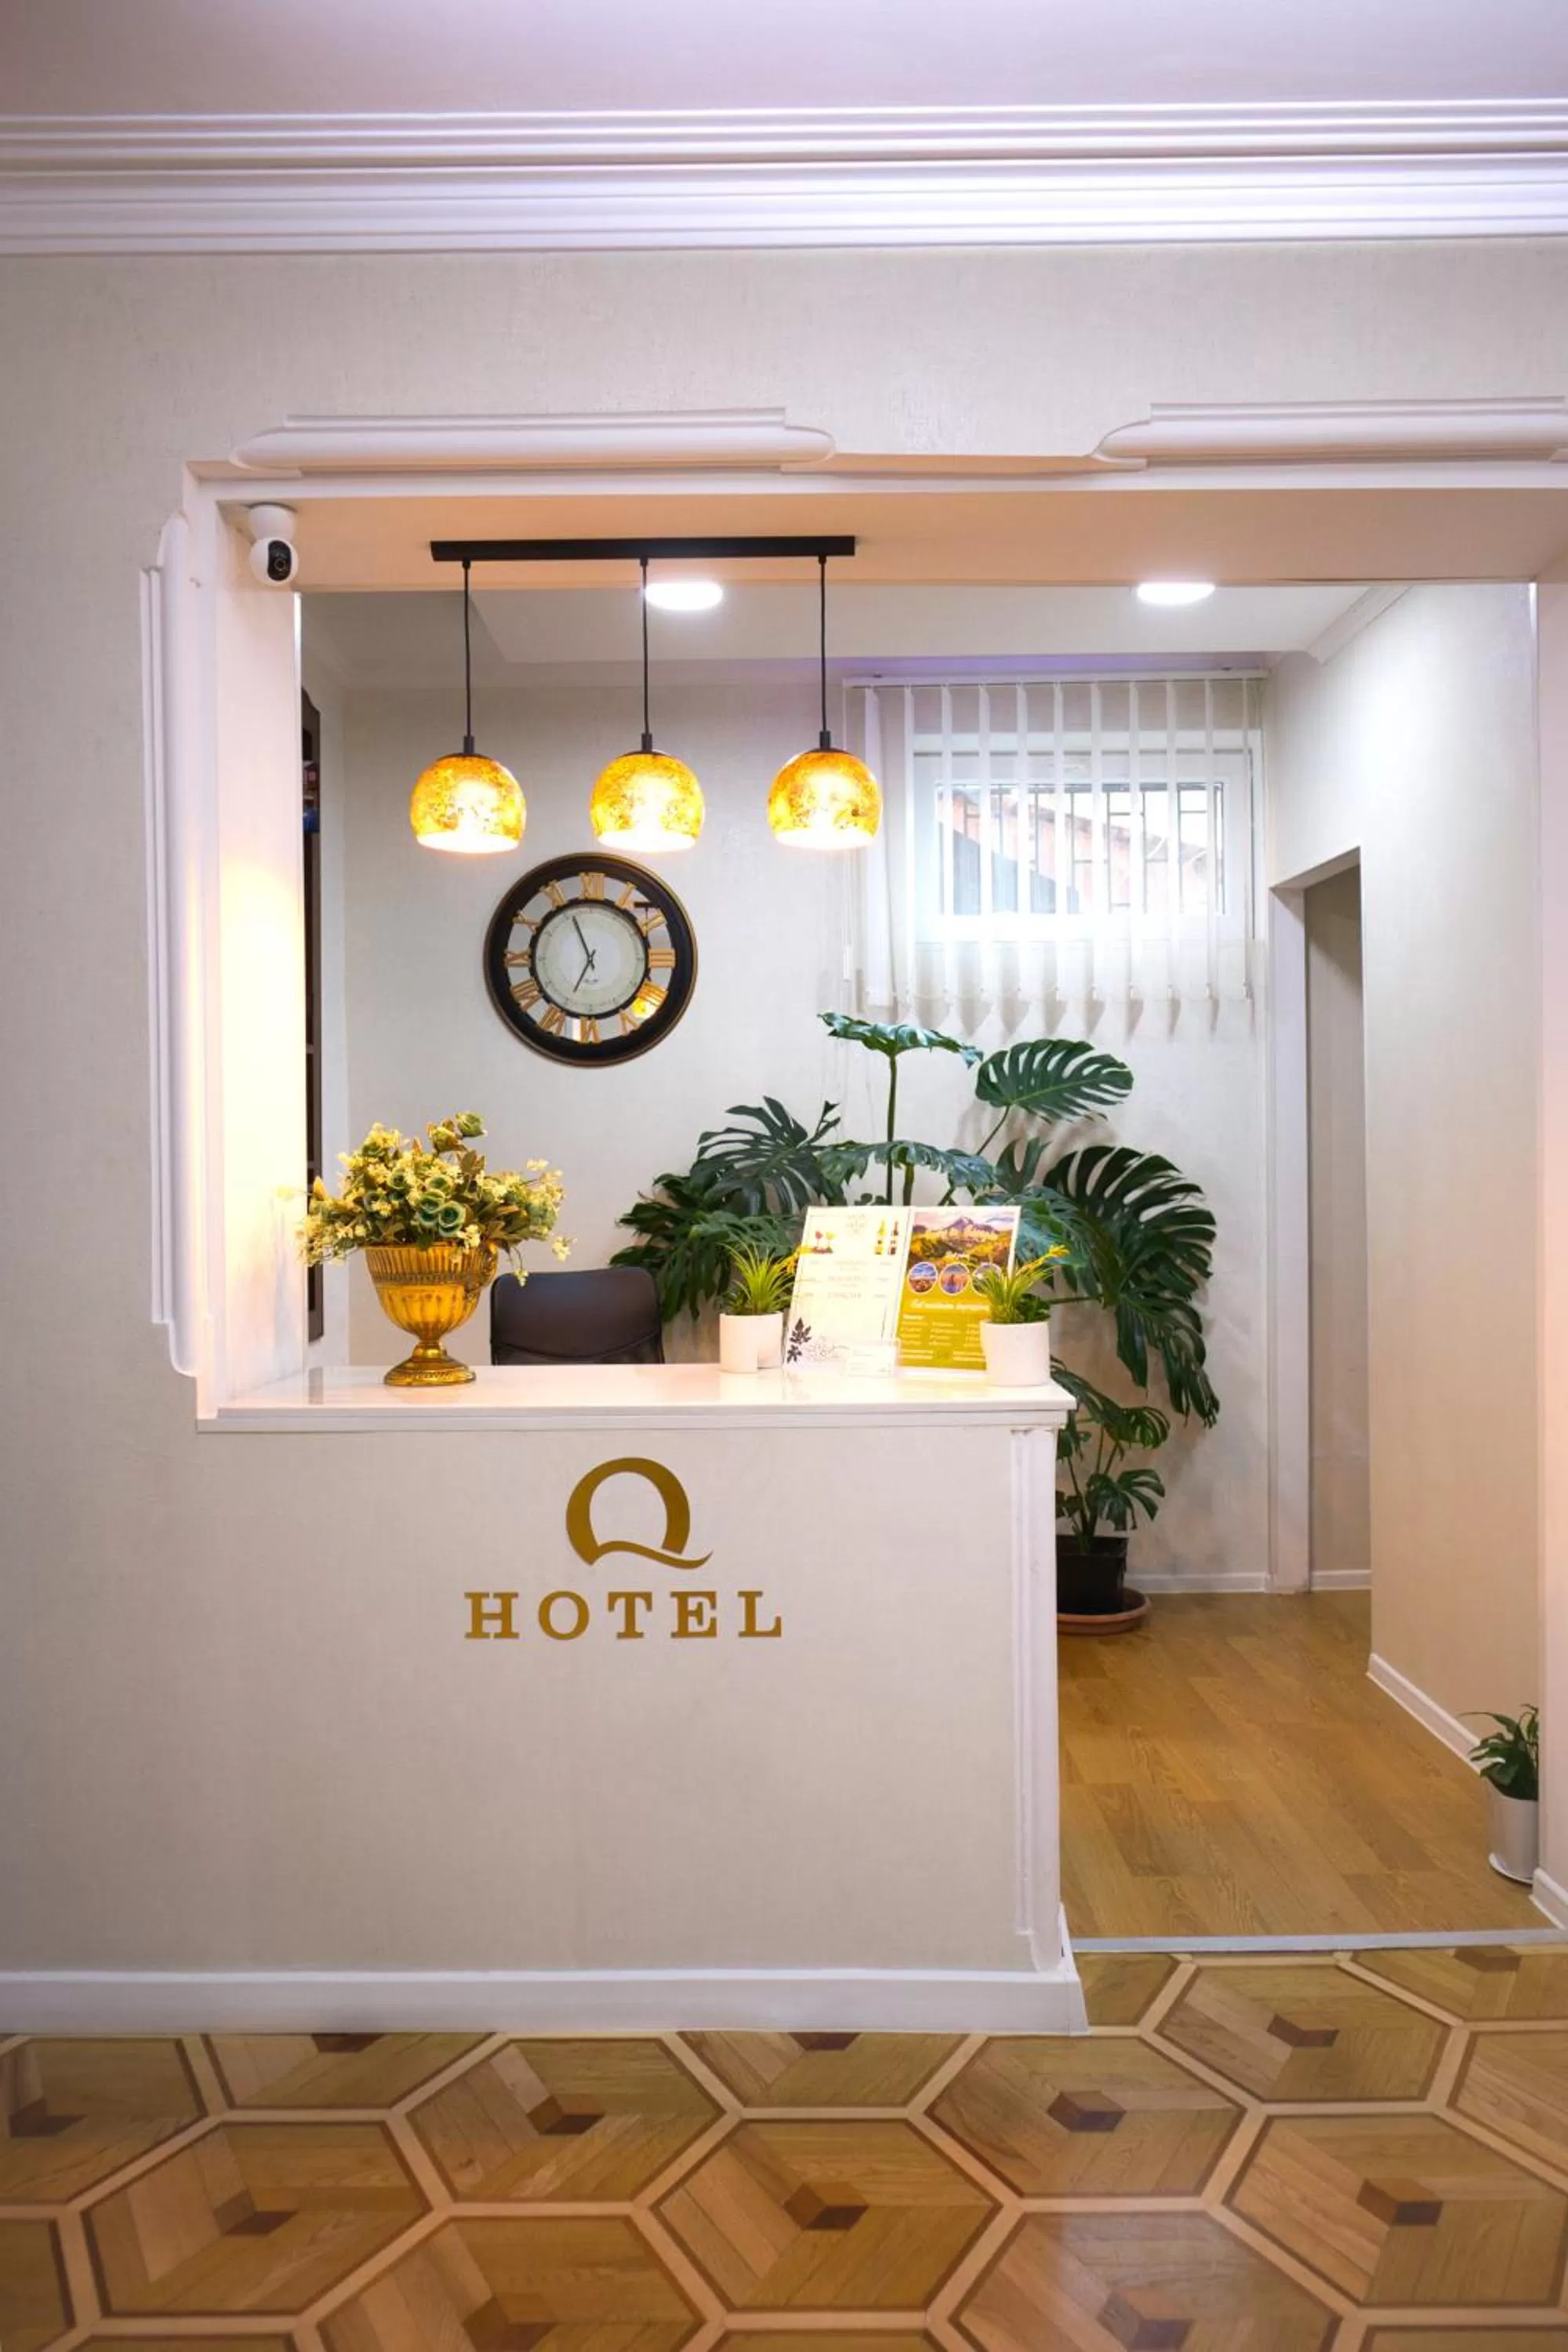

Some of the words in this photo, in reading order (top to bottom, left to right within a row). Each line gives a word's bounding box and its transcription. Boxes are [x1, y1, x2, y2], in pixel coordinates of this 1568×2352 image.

[539, 880, 568, 910] XI
[578, 872, 605, 900] XII
[615, 880, 637, 909] I
[513, 911, 539, 935] X
[636, 908, 666, 937] II
[504, 947, 532, 969] IX
[648, 947, 676, 968] III
[538, 1004, 566, 1036] VII
[579, 1016, 602, 1044] VI
[618, 1008, 640, 1035] V
[565, 1457, 714, 1570] Q
[464, 1591, 782, 1640] HOTEL
